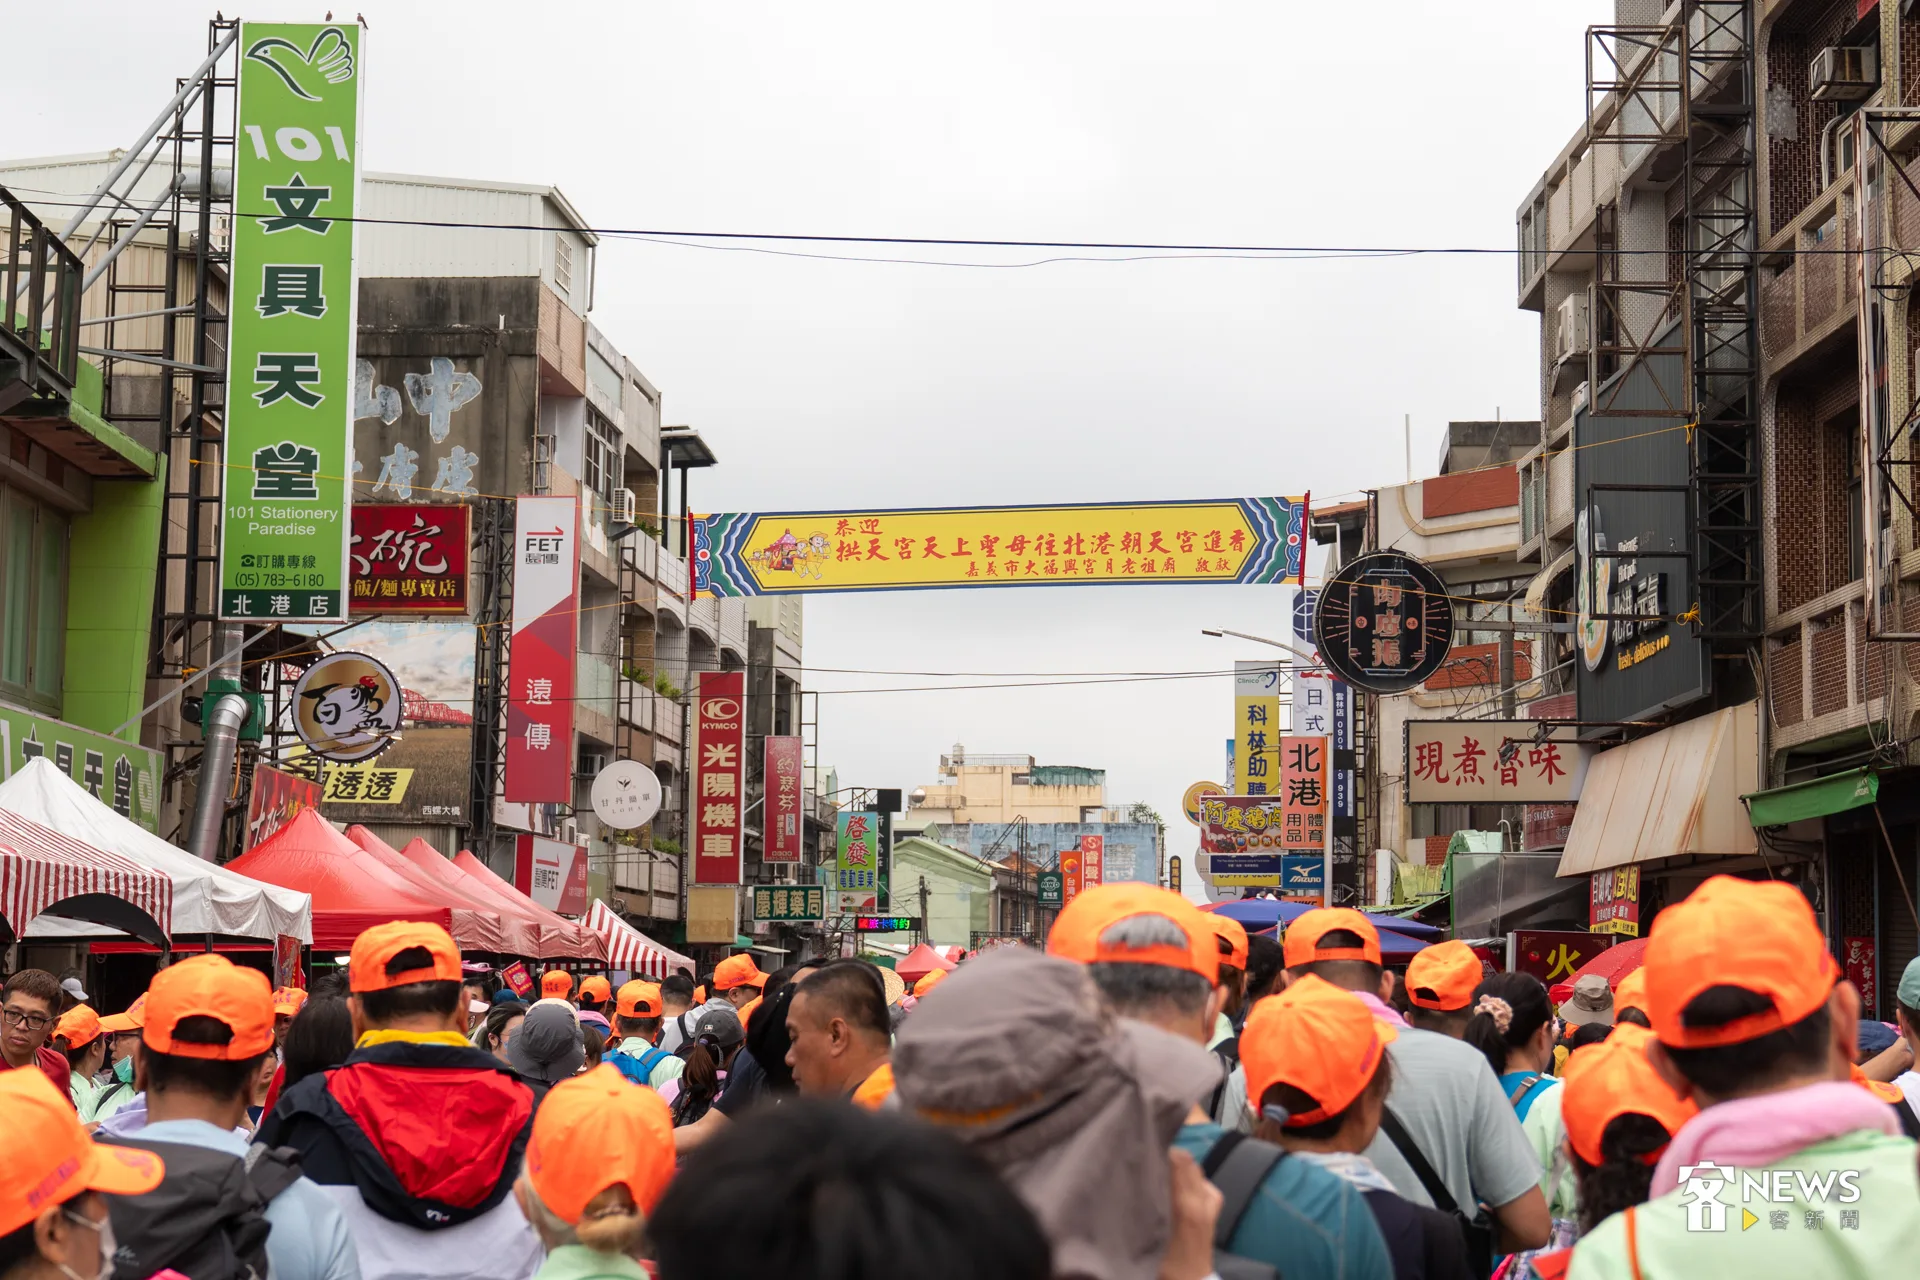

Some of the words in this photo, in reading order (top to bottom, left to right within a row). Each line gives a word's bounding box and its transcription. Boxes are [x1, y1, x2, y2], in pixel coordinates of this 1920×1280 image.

[244, 126, 351, 163] 101
[251, 173, 333, 501] 文具天堂
[228, 506, 257, 520] 101
[261, 505, 339, 523] Stationery
[248, 522, 317, 537] Paradise
[834, 518, 883, 537] 恭迎
[526, 538, 564, 552] FET
[835, 529, 1247, 563] 拱天宮天上聖母往北港朝天宮進香
[256, 554, 316, 570] 訂購專線
[234, 573, 260, 588] (05)
[264, 572, 325, 588] 783-6180
[349, 578, 456, 597] 飯/麵專賣店
[232, 594, 329, 616] 北港店
[524, 677, 553, 752] 遠傳
[1305, 689, 1324, 732] 日式
[1335, 692, 1344, 717] 雲林店
[1247, 704, 1268, 795] 科林助聽
[1288, 743, 1321, 807] 北港
[422, 805, 461, 816] 西螺大橋
[701, 742, 738, 858] 光陽機車
[756, 890, 822, 918] 慶輝藥局
